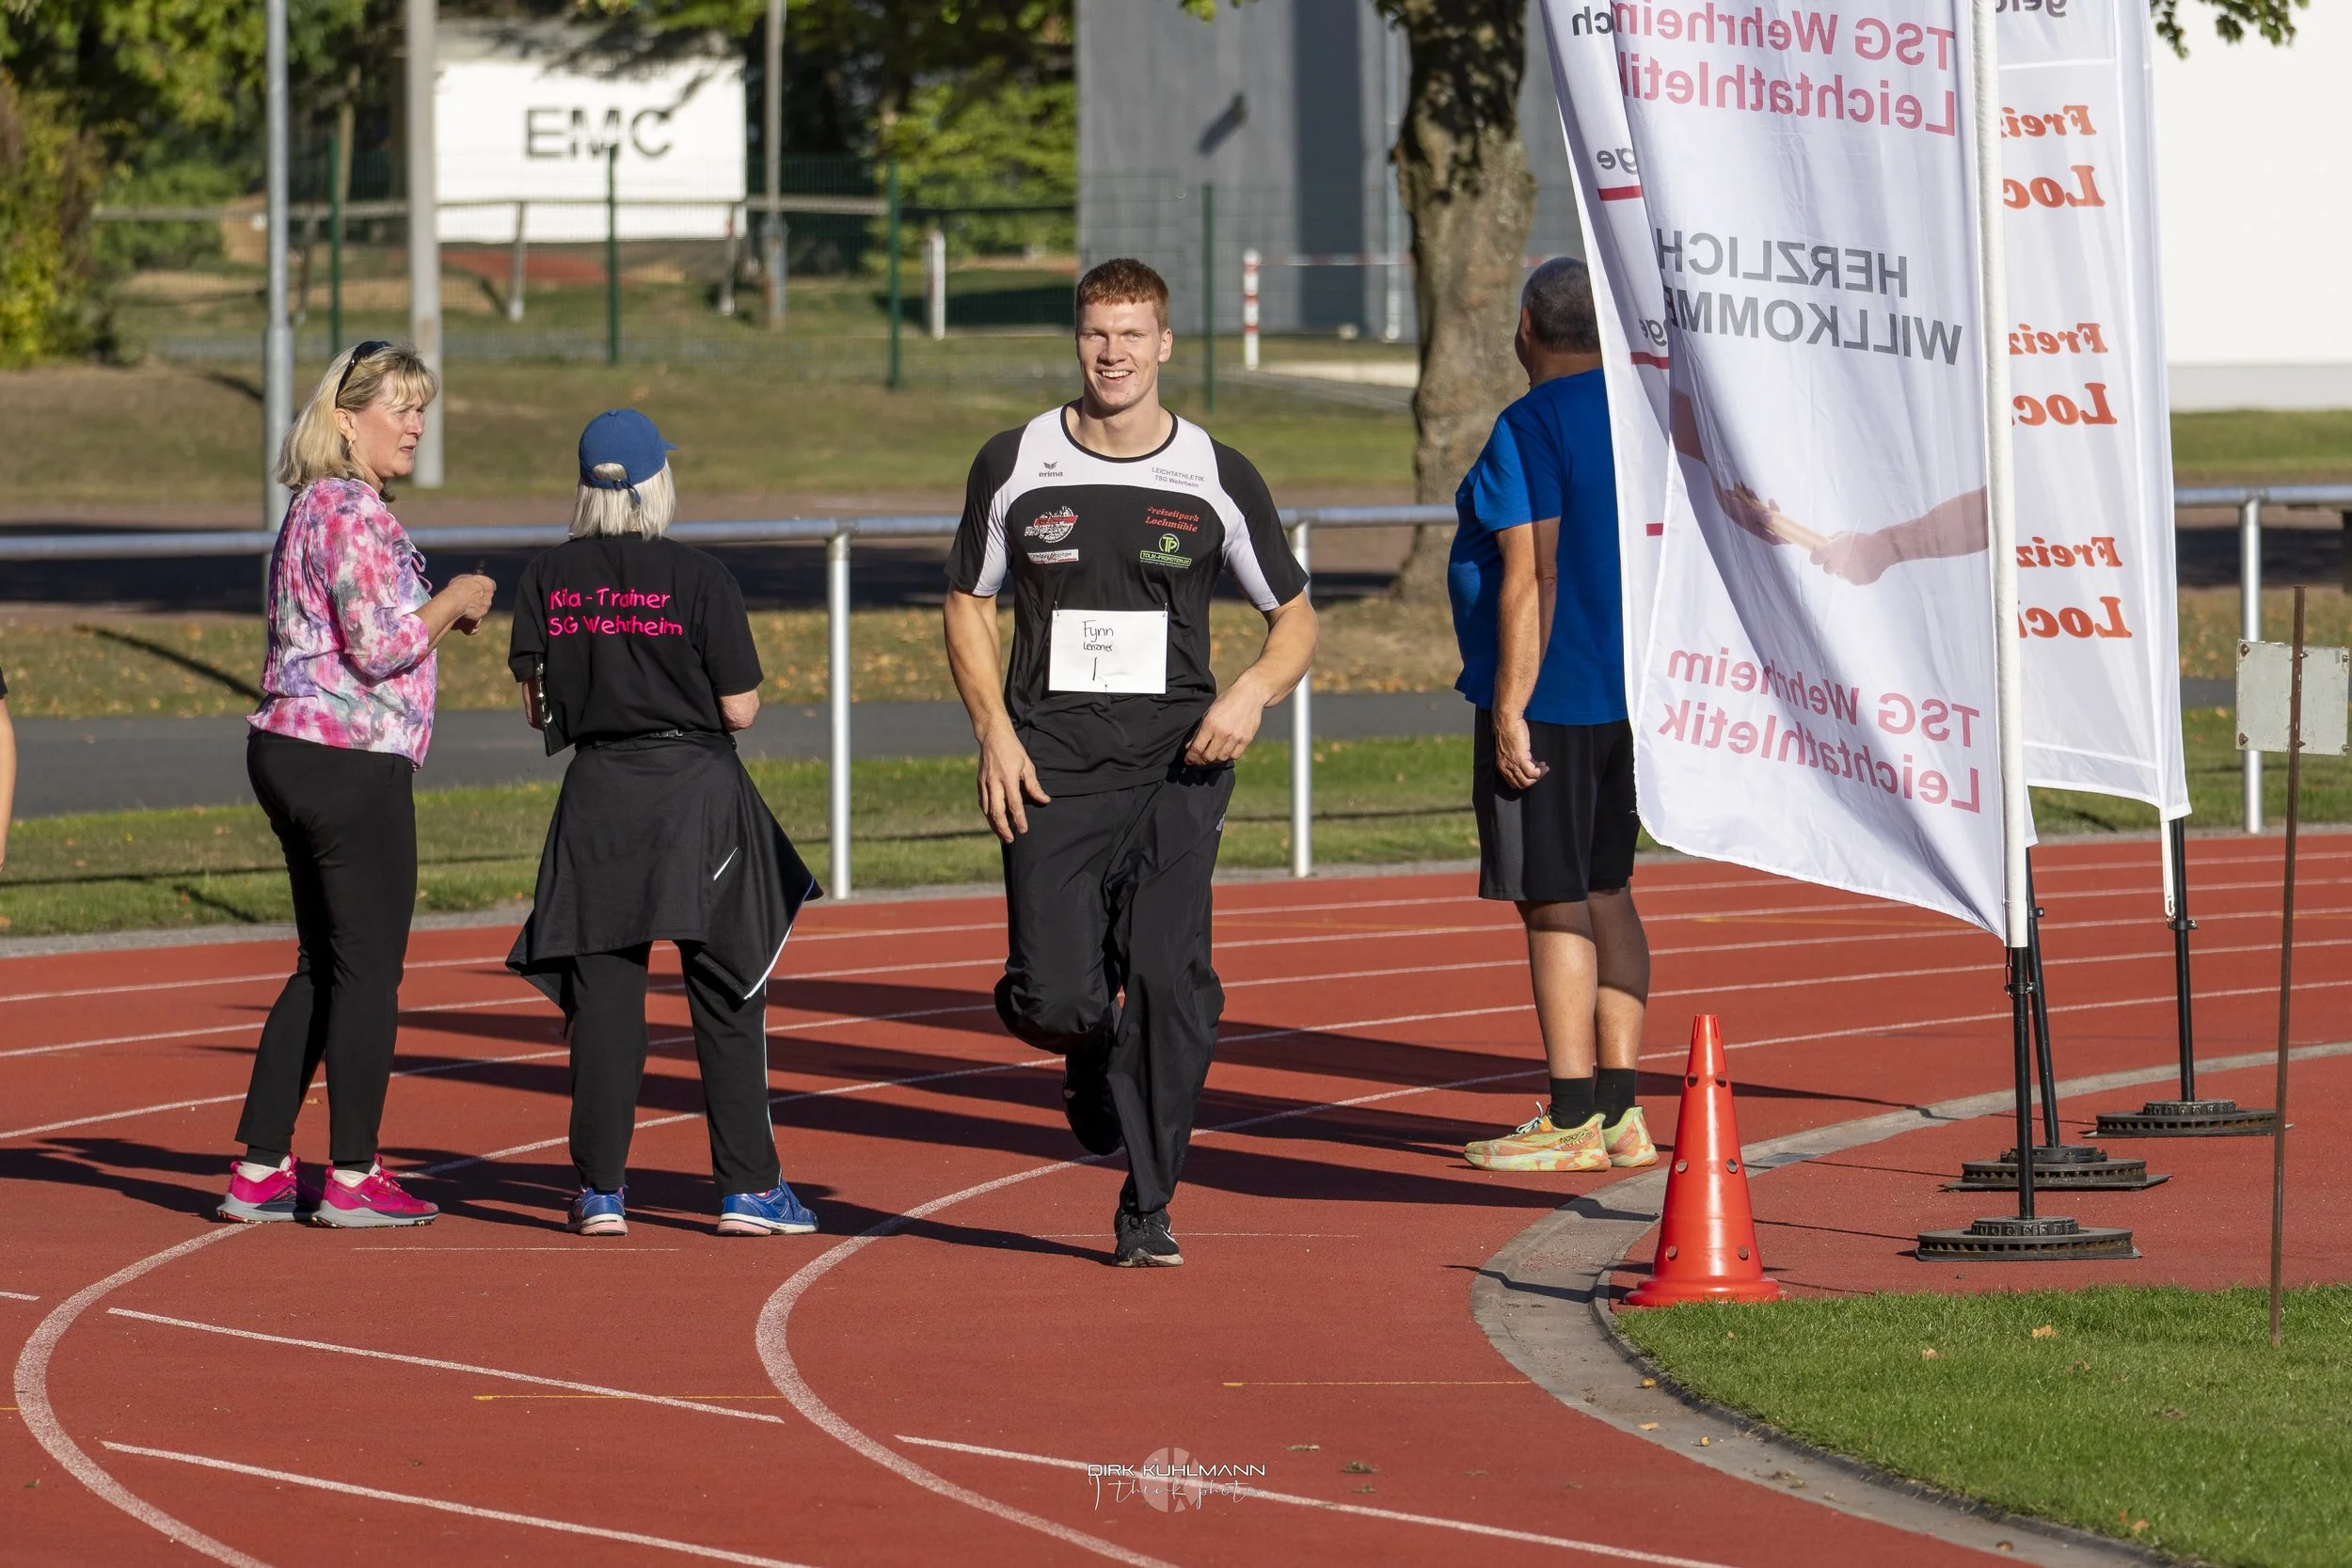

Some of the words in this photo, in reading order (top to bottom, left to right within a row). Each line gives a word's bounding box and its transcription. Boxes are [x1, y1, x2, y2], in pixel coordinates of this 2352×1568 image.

[525, 106, 675, 159] EMC
[1152, 467, 1205, 483] LEICHTATHLETIK
[1168, 478, 1200, 489] Wehrheim
[1144, 516, 1199, 532] Lochmühle
[596, 587, 671, 610] Trainer
[549, 614, 579, 637] SG
[582, 614, 683, 637] Wehrheim
[1082, 619, 1115, 643] Fynn
